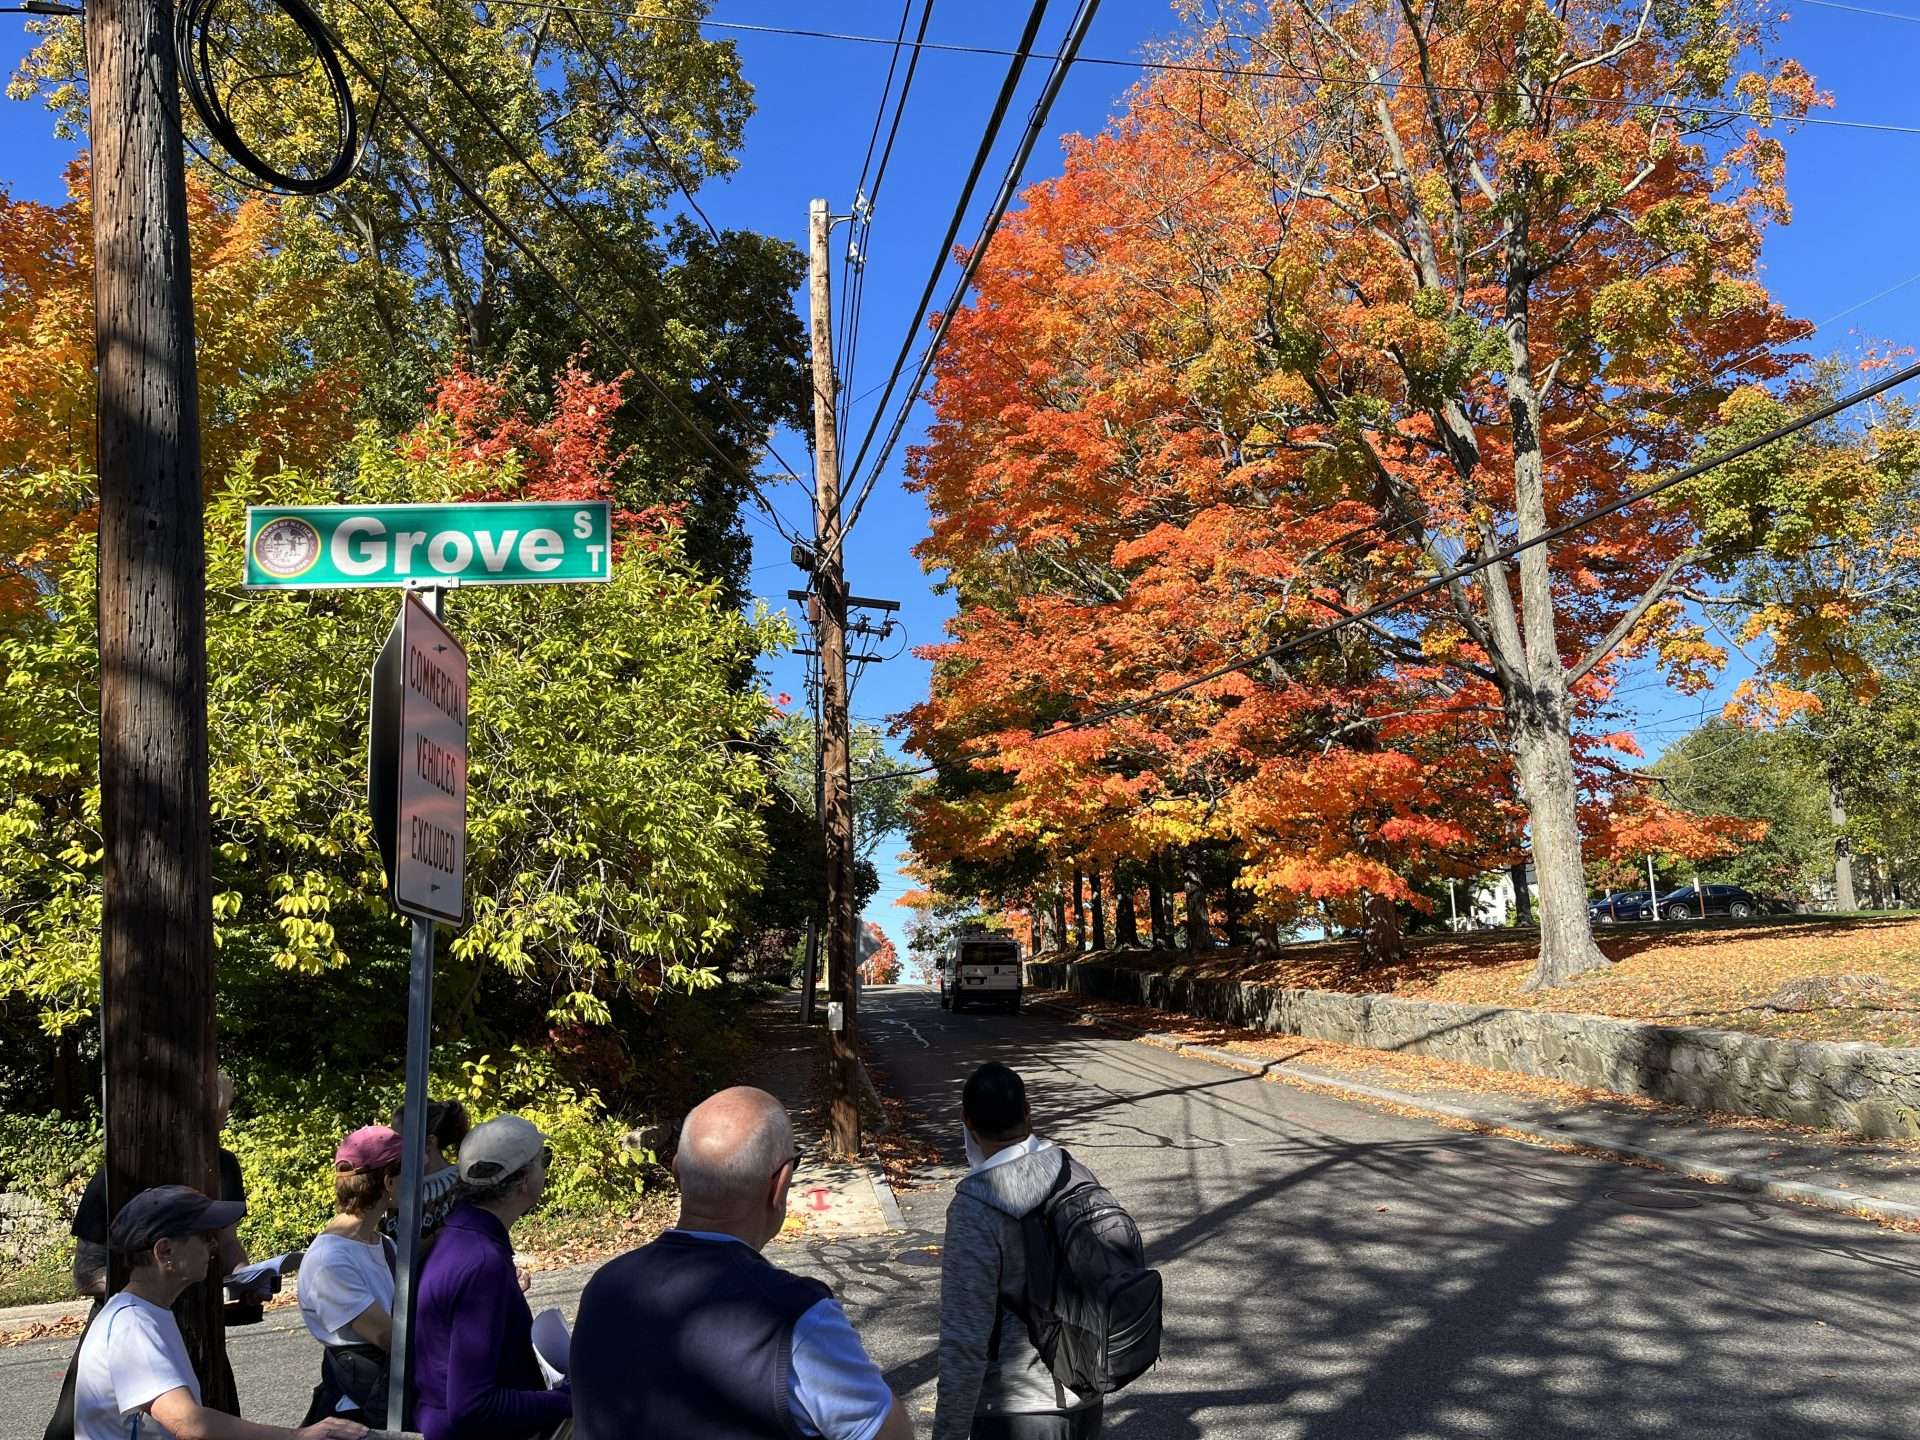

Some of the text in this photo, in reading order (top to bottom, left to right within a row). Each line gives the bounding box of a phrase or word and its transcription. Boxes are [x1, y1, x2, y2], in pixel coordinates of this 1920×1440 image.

[330, 516, 565, 576] Grove
[409, 644, 463, 728] COMMERCIAL
[416, 732, 456, 797] VEHICLES
[411, 815, 456, 875] EXCLUDED
